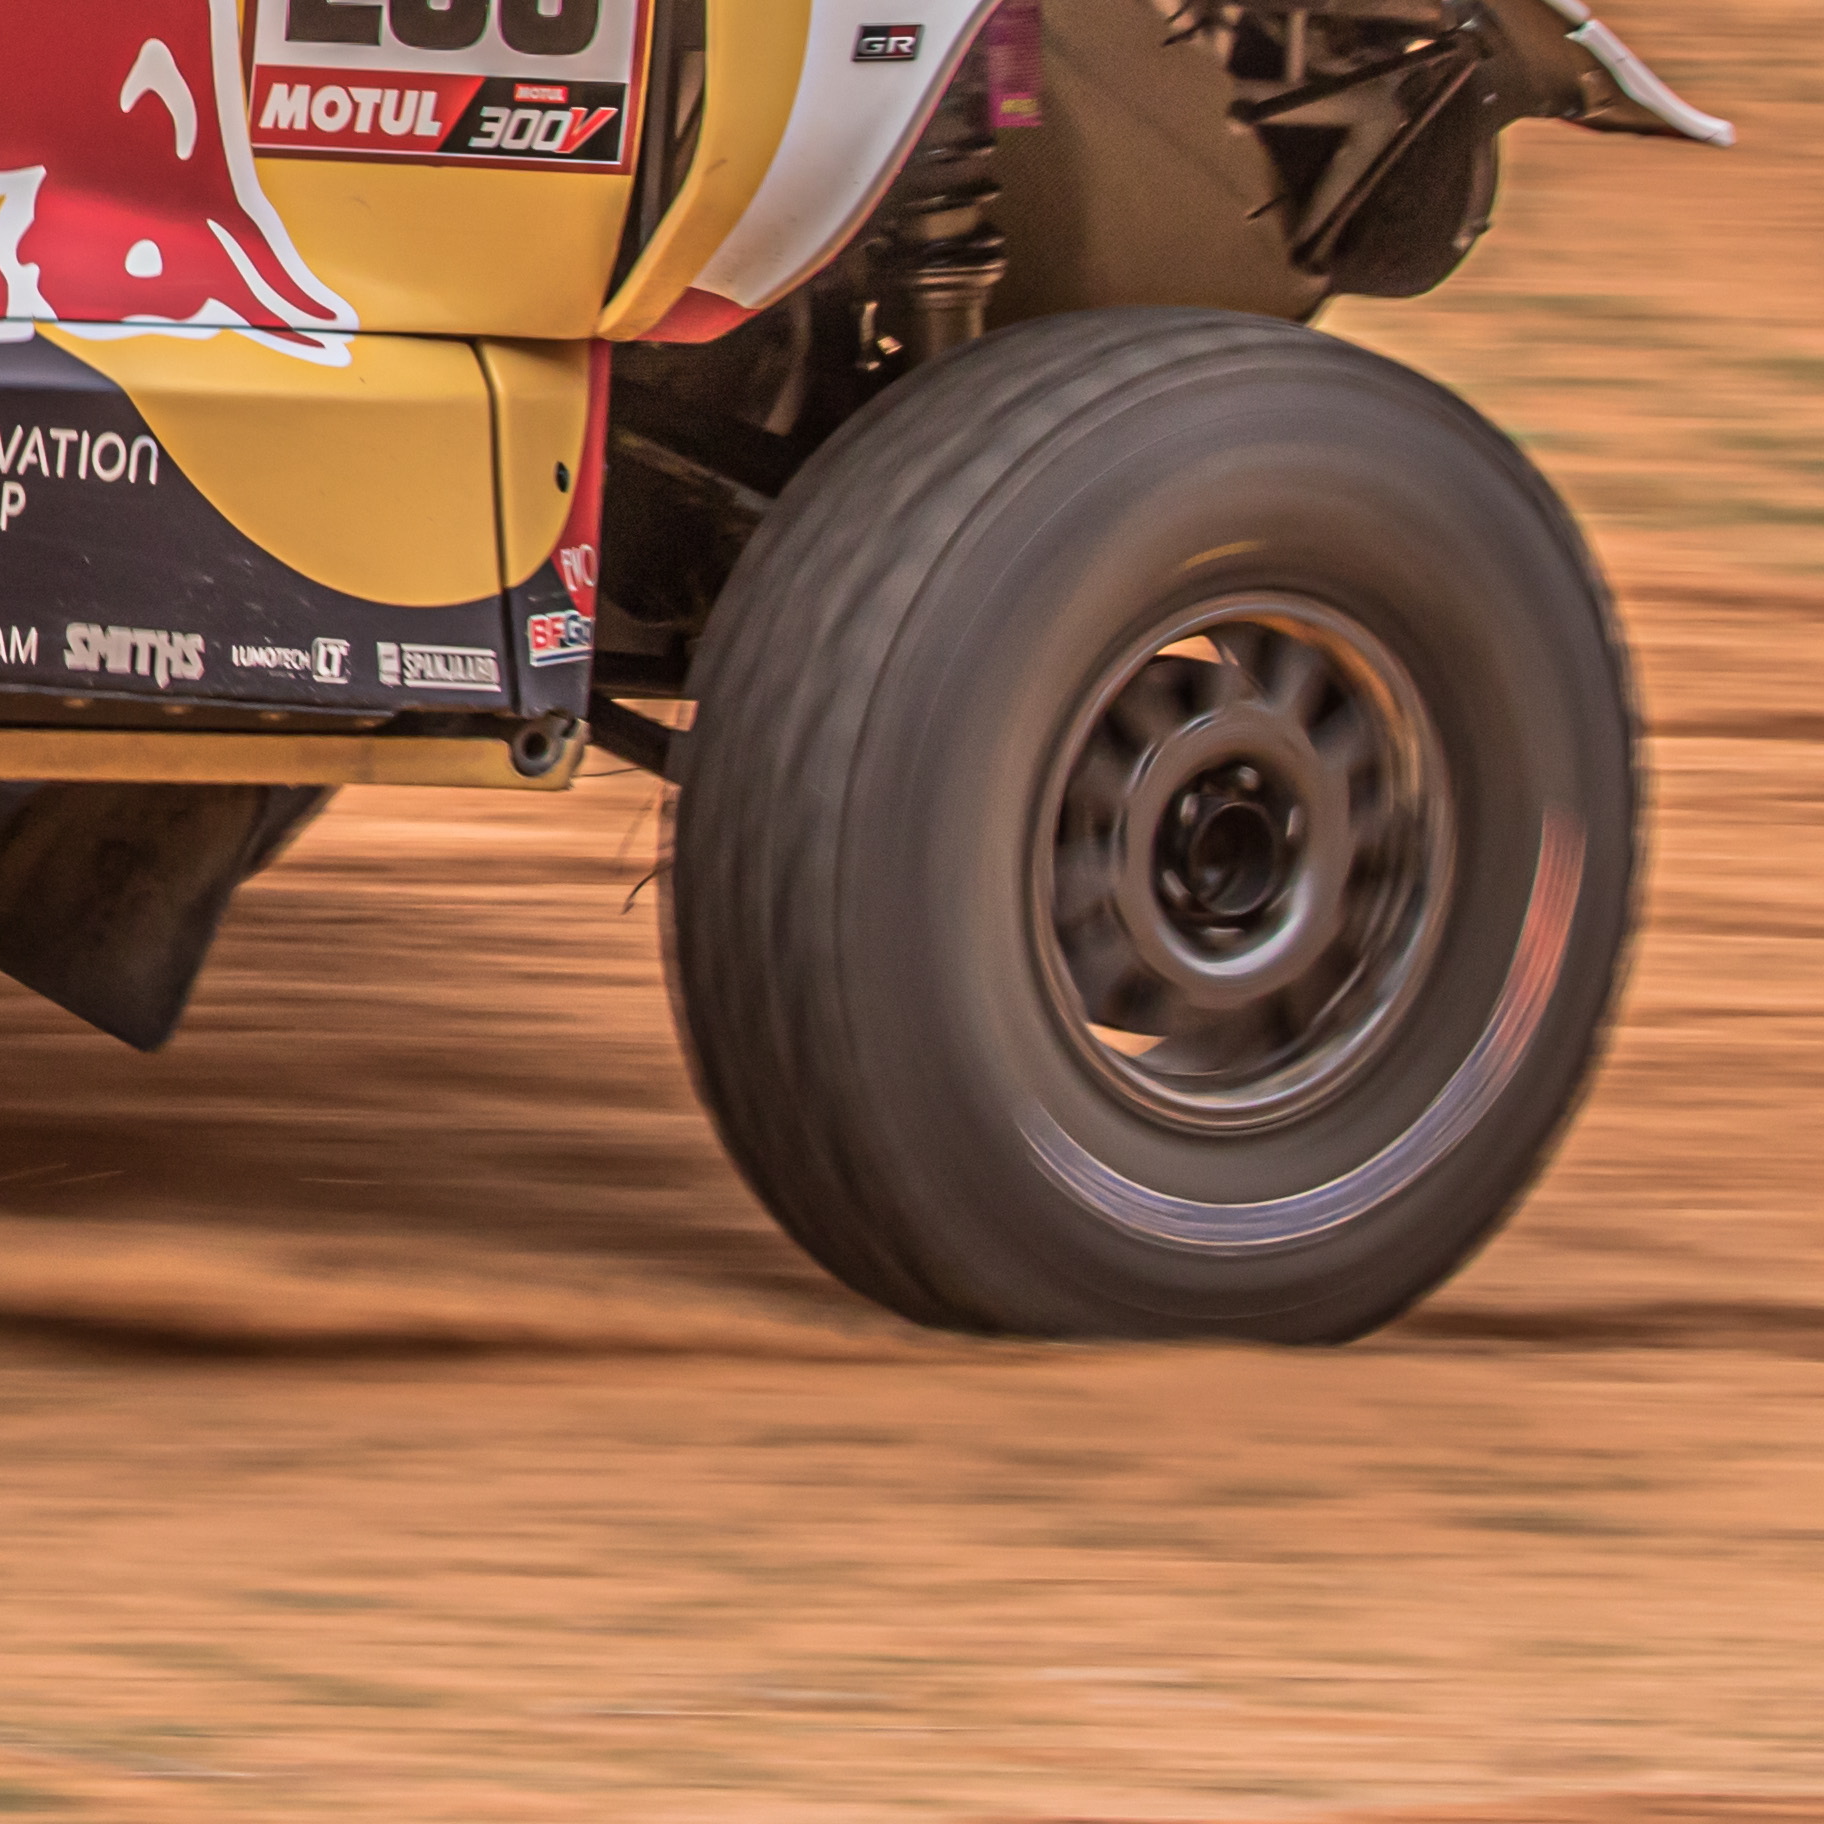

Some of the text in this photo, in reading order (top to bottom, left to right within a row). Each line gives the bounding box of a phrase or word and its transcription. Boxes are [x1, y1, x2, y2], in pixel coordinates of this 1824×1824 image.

[858, 36, 916, 55] GR
[259, 83, 442, 137] MOTUL
[468, 107, 618, 153] 300V
[64, 623, 204, 689] SMITHS
